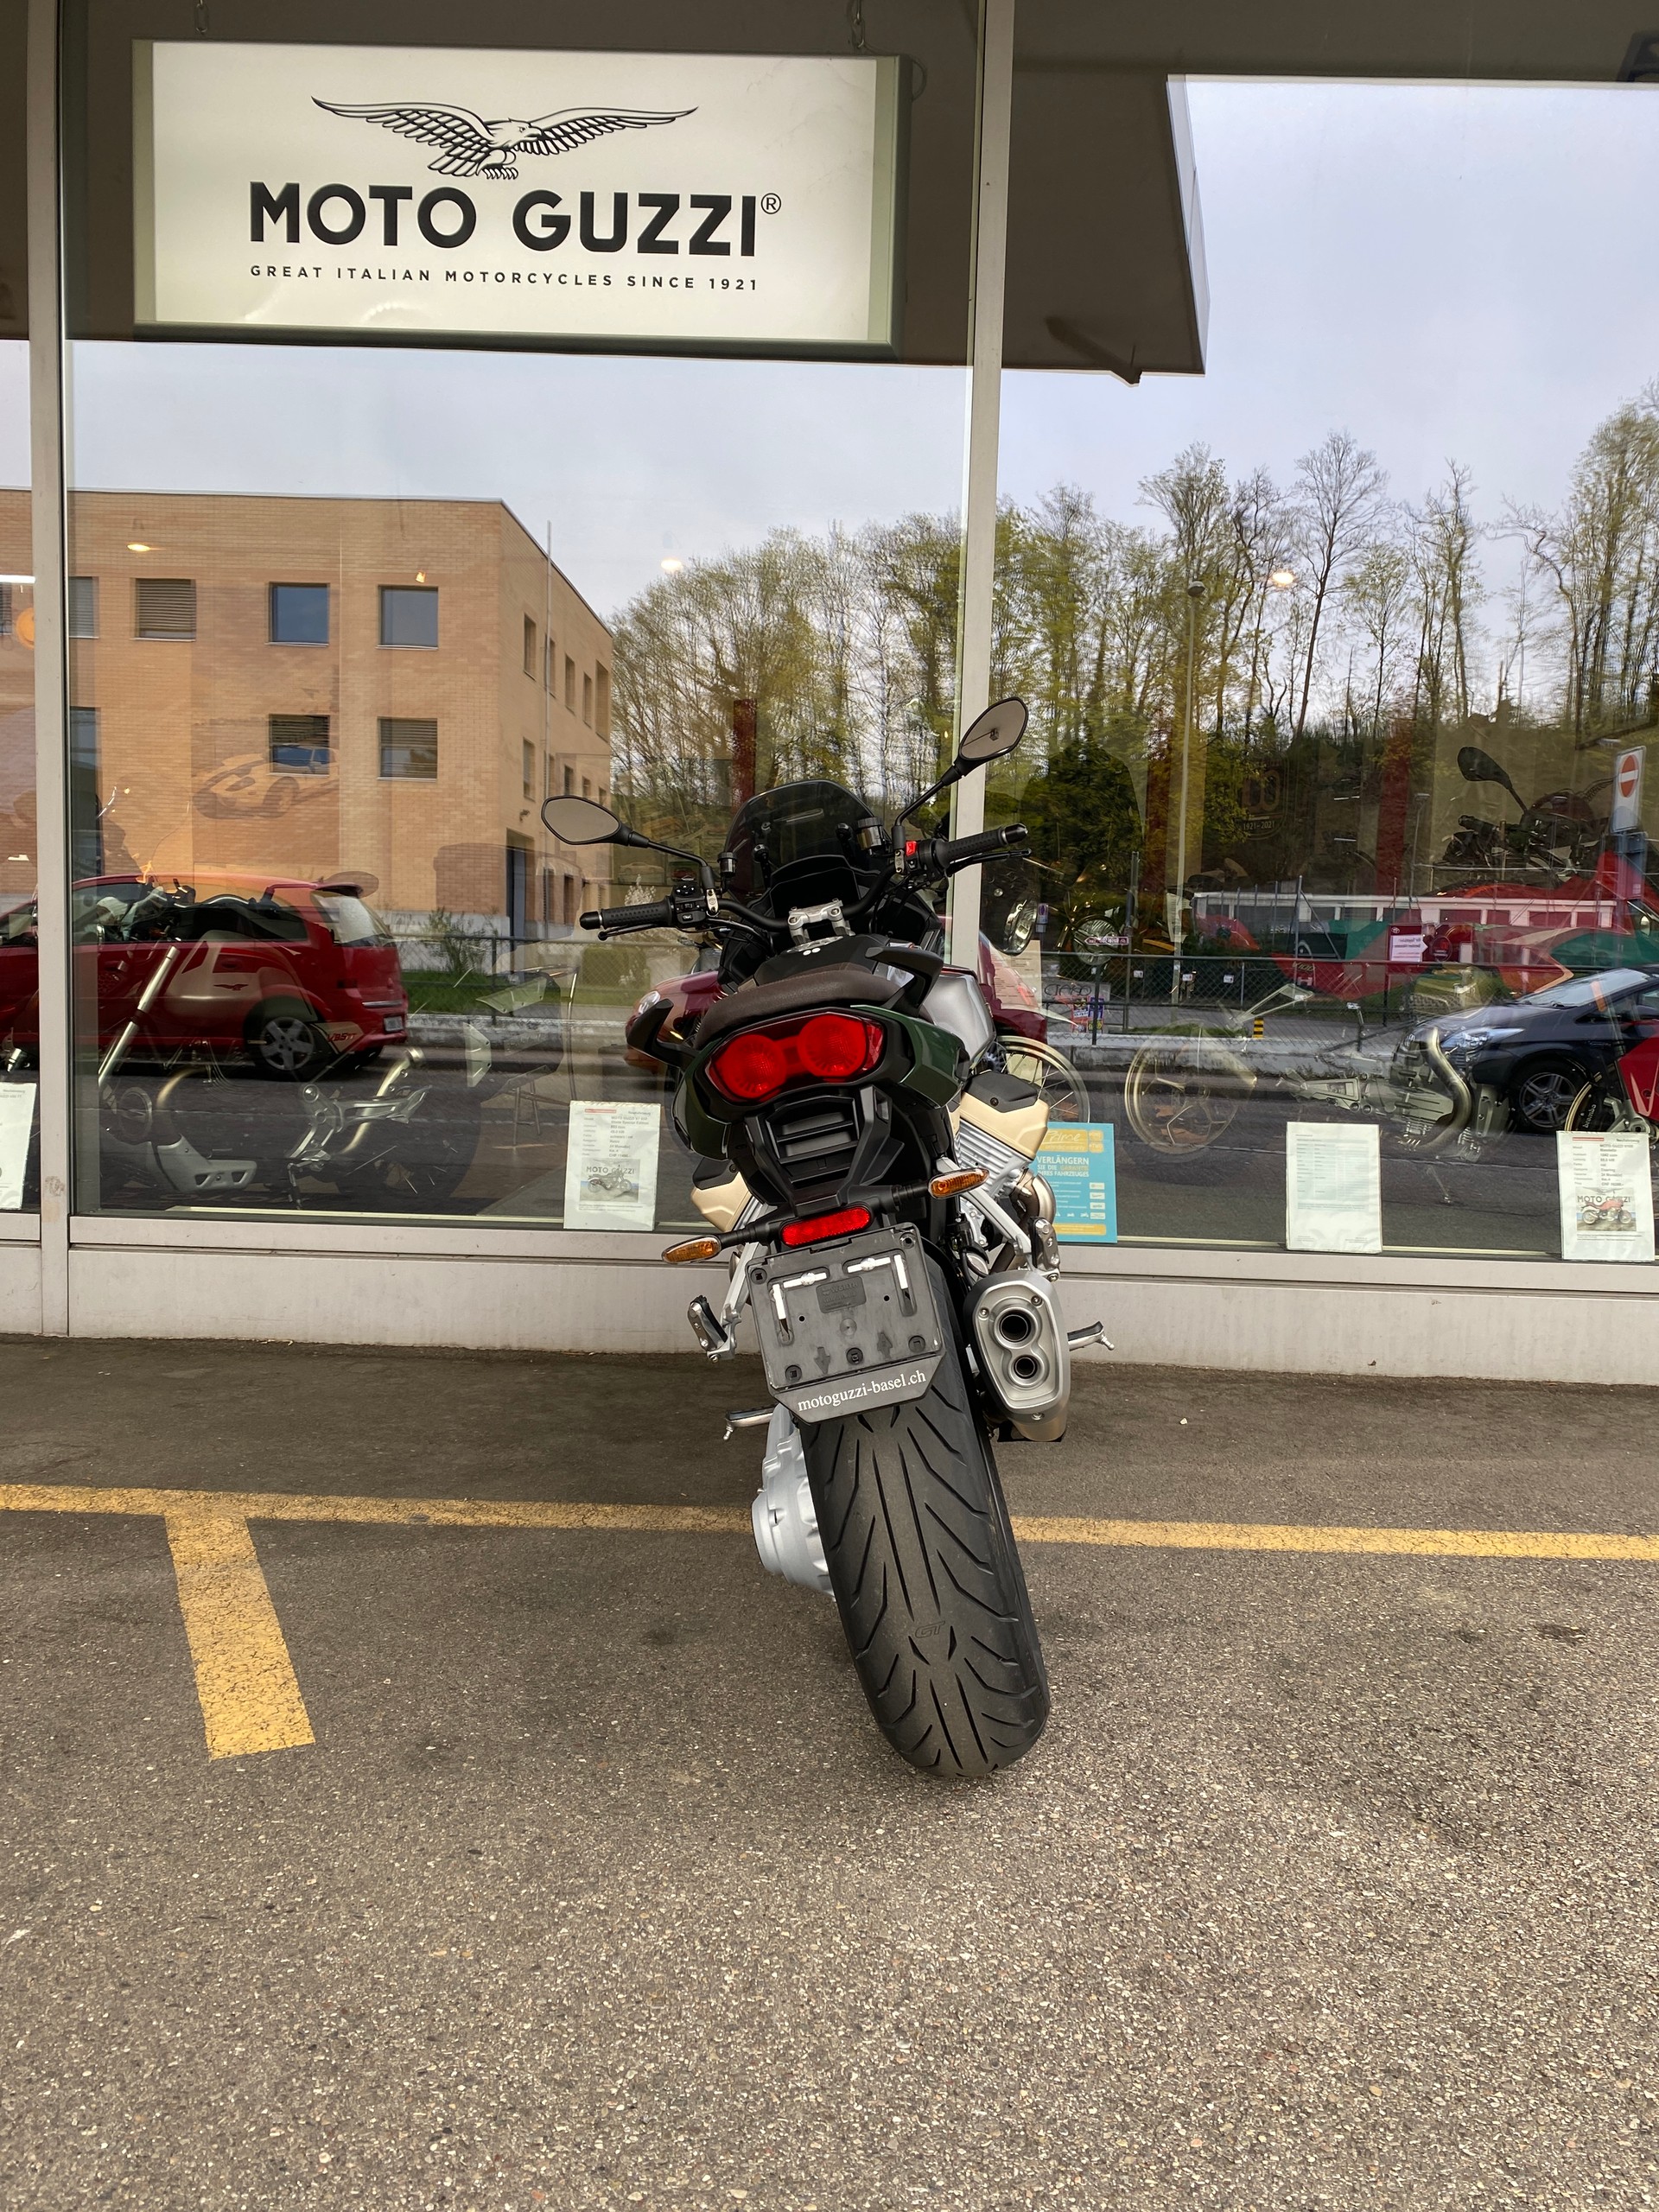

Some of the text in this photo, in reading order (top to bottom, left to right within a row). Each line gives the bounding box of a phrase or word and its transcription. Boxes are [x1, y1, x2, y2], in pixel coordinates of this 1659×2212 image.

[250, 181, 477, 248] MOTO
[251, 265, 756, 290] GREAT ITALIAN MOTORCYCLES SINCE 1921
[1582, 1103, 1598, 1128] brembo
[586, 1166, 609, 1174] MOTO
[1037, 1154, 1090, 1166] VERLÄNGERN
[798, 1370, 926, 1412] motoguzzi-basel.ch
[914, 1619, 946, 1639] GT
